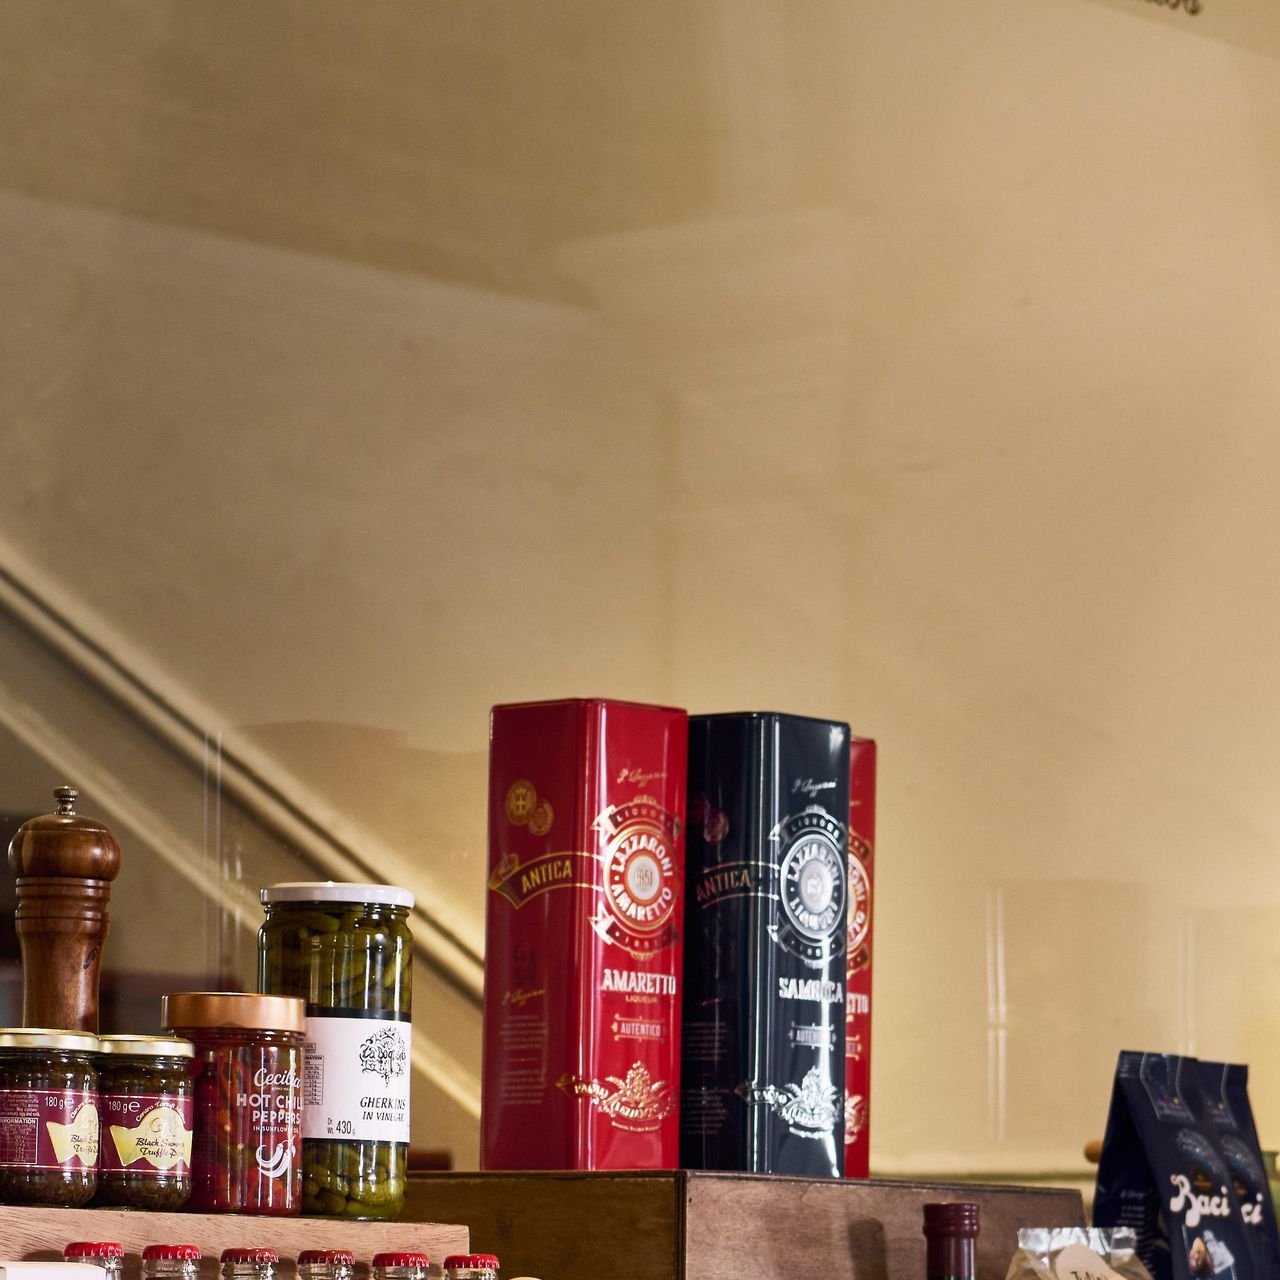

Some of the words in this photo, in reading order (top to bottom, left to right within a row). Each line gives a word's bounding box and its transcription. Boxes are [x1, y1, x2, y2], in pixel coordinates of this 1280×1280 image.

[611, 834, 673, 878] LAZZARONI
[521, 859, 573, 894] ANTICA
[696, 869, 753, 901] ANTICA
[611, 885, 672, 922] AMARETTO
[599, 968, 677, 996] AMARETTO
[620, 1022, 662, 1037] AUTENTICO
[253, 1066, 302, 1088] Cecilia
[45, 1096, 58, 1107] 180
[108, 1101, 120, 1112] 180
[235, 1093, 271, 1108] HOT
[359, 1095, 406, 1112] GHERKINS
[252, 1109, 302, 1125] PEPPERS
[362, 1111, 374, 1121] IN
[335, 1120, 352, 1135] 430
[135, 1137, 159, 1148] Black
[1170, 1173, 1231, 1228] Baci
